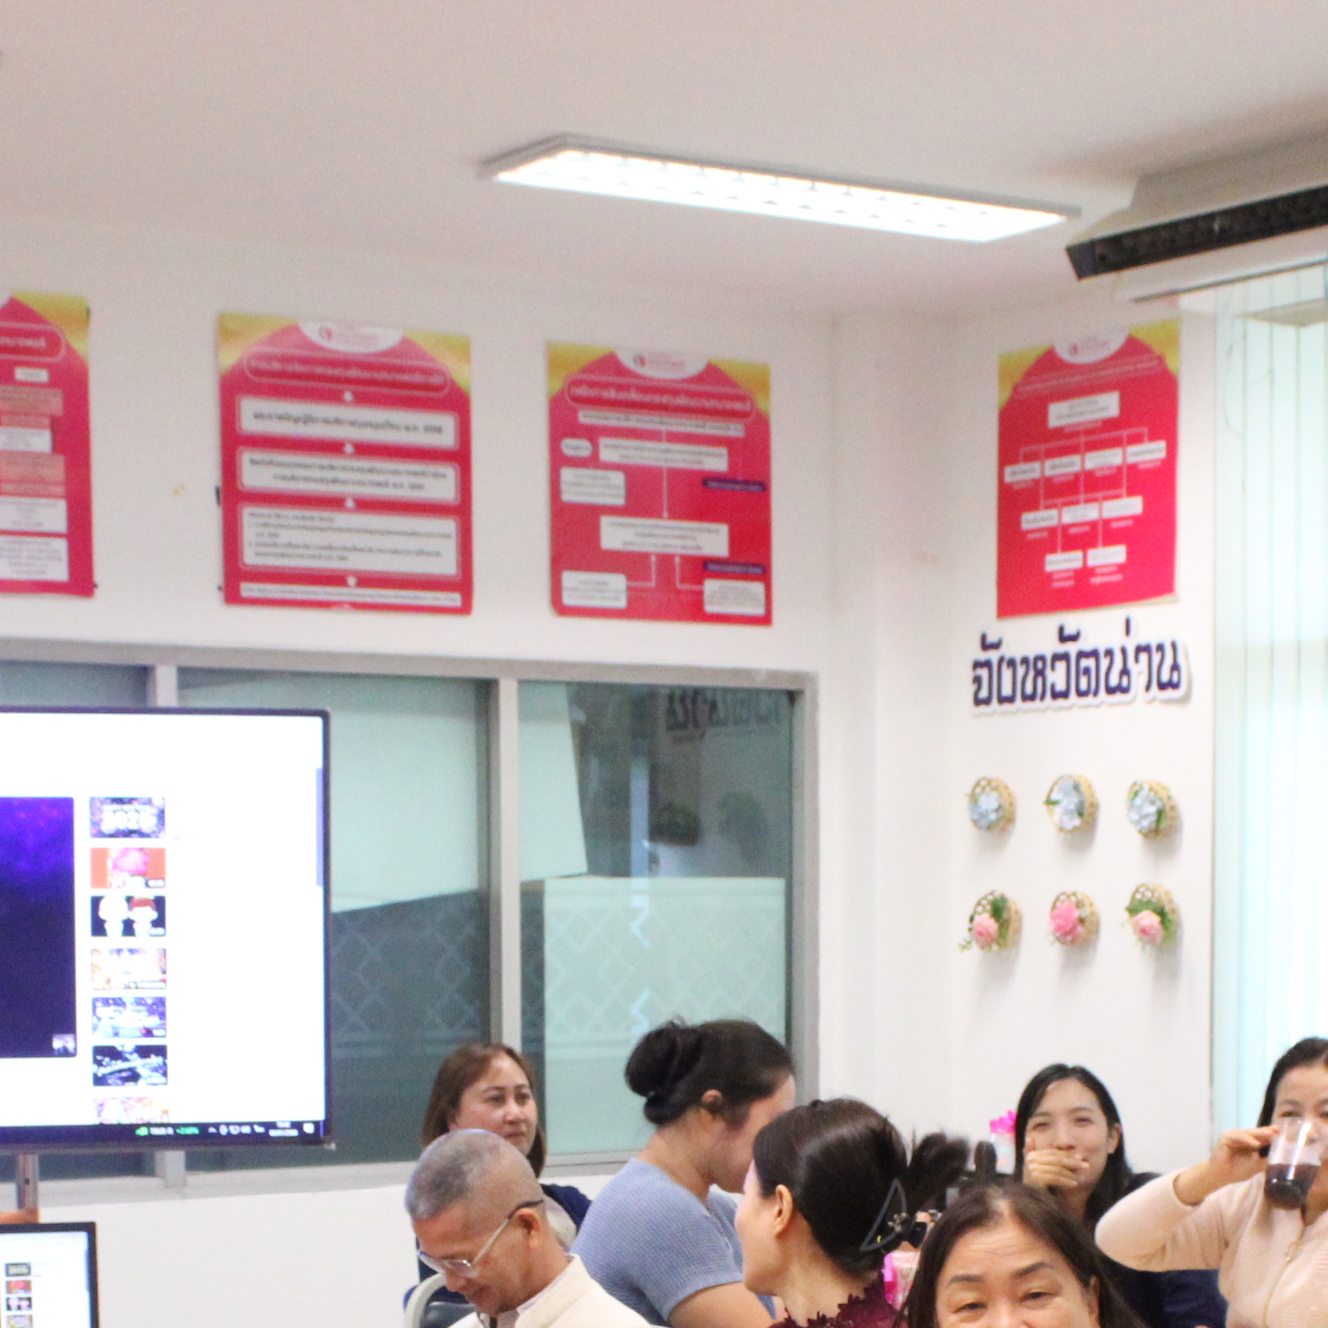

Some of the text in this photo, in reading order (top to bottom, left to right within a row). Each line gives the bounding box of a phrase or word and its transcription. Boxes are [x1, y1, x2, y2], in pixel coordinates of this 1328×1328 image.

[972, 616, 1182, 706] จังหวัดน่าน
